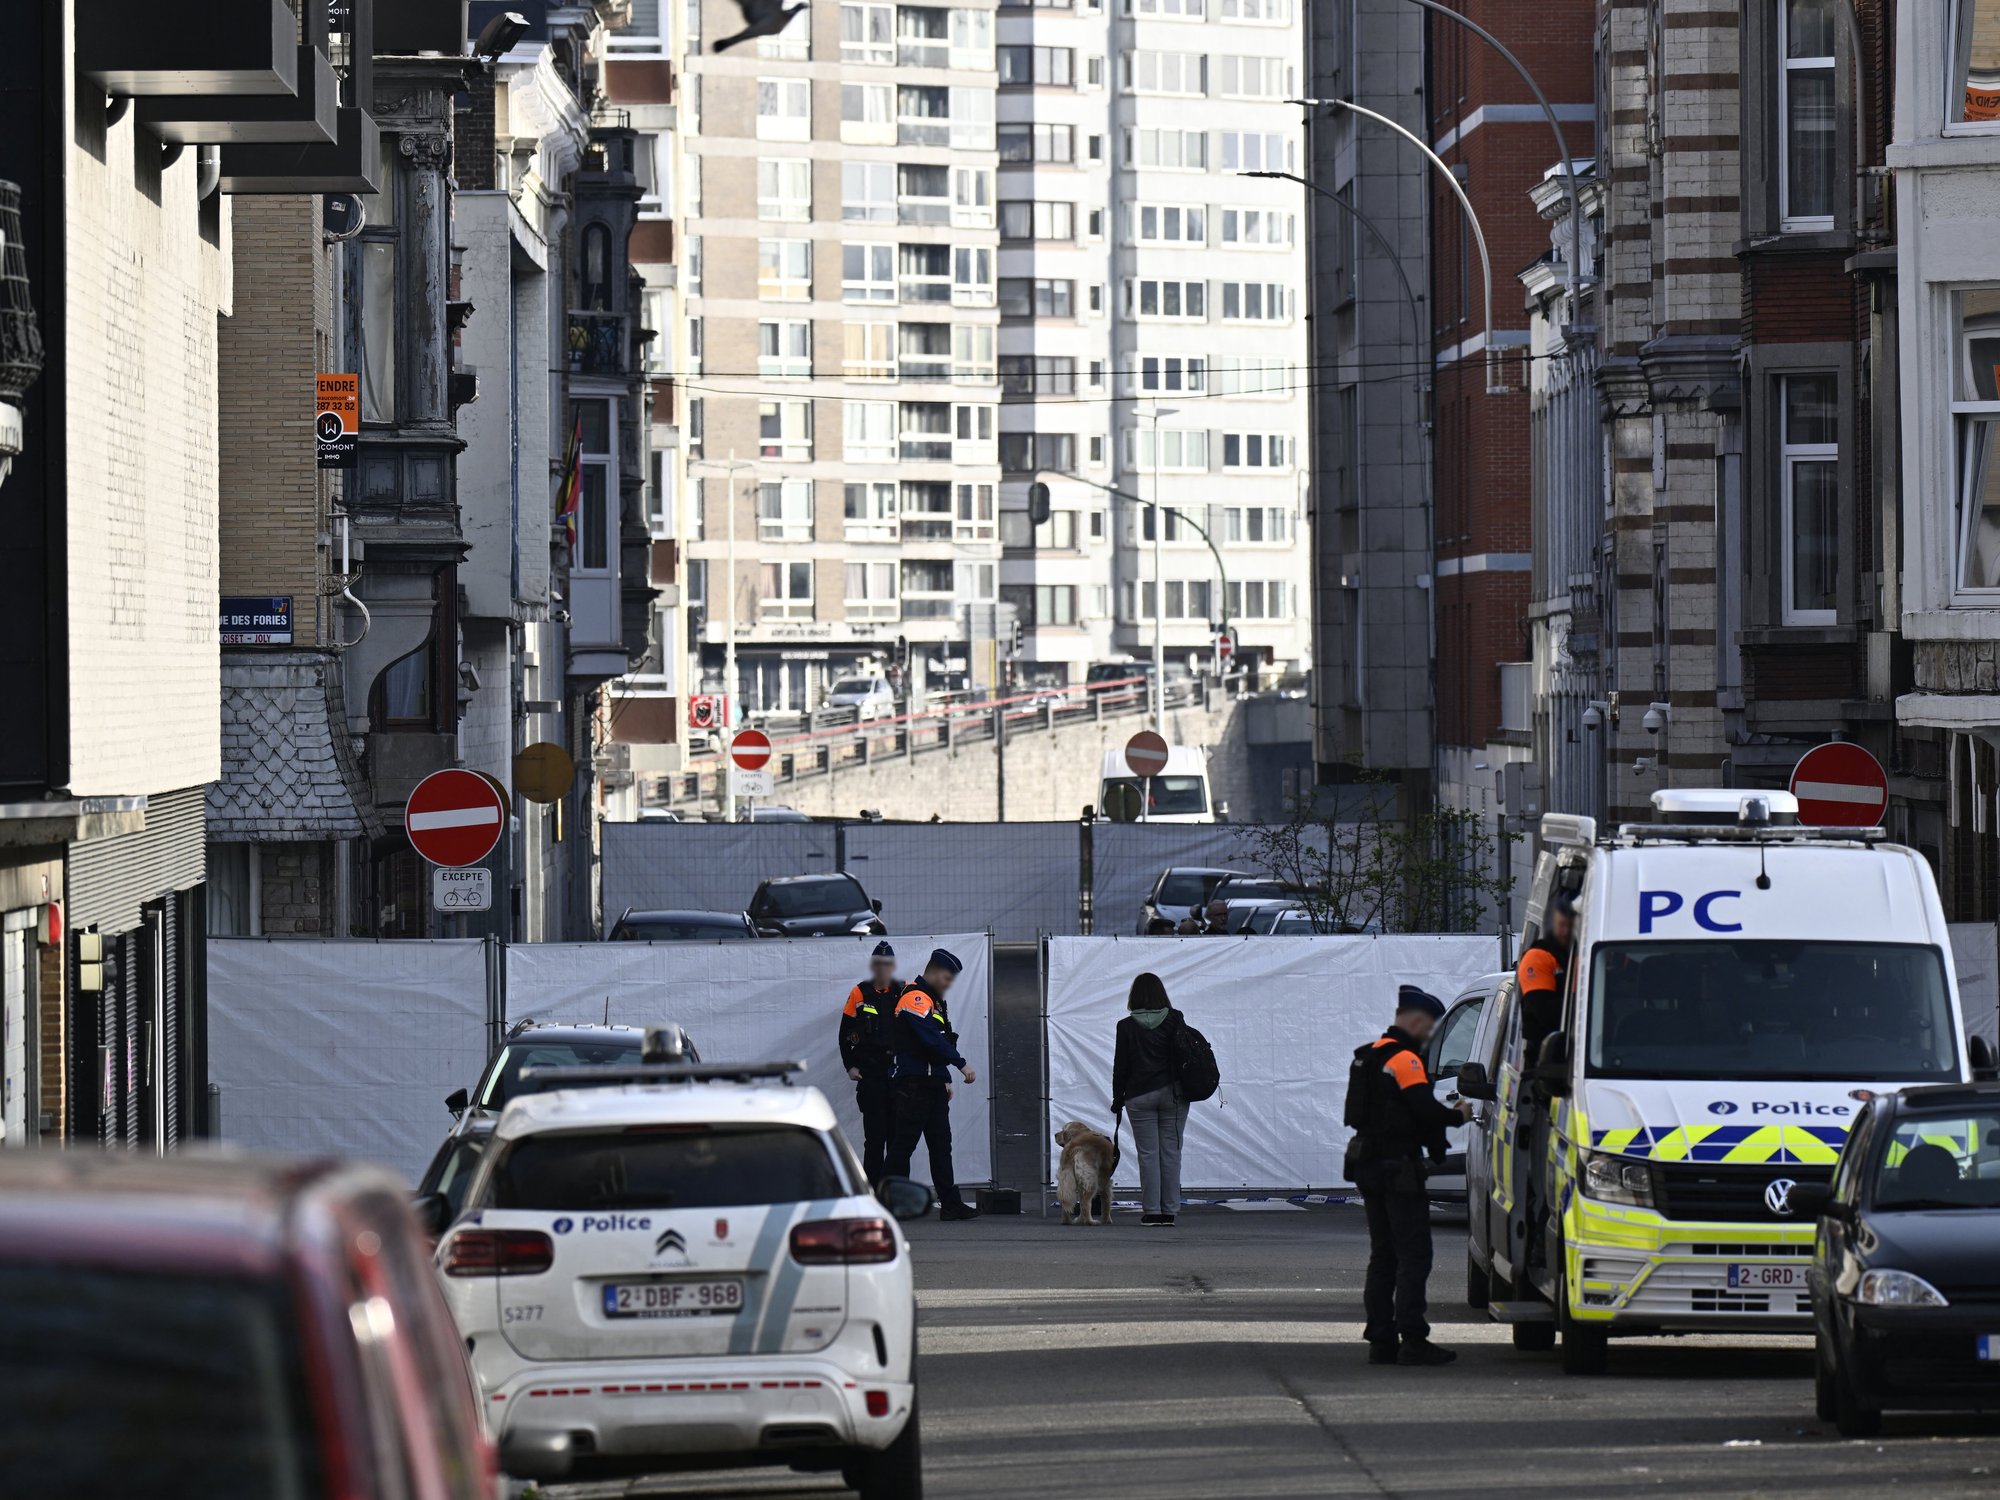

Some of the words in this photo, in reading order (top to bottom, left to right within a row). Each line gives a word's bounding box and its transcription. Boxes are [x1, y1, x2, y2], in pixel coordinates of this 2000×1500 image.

[332, 402, 343, 410] 32
[344, 402, 355, 410] 82
[231, 615, 250, 625] DES
[253, 615, 287, 625] FORIES
[222, 634, 244, 643] CISET
[254, 634, 272, 643] JOLY
[442, 872, 483, 881] EXCEPTE
[1639, 890, 1743, 934] PC
[1751, 1101, 1850, 1116] Police
[582, 1214, 652, 1233] Police
